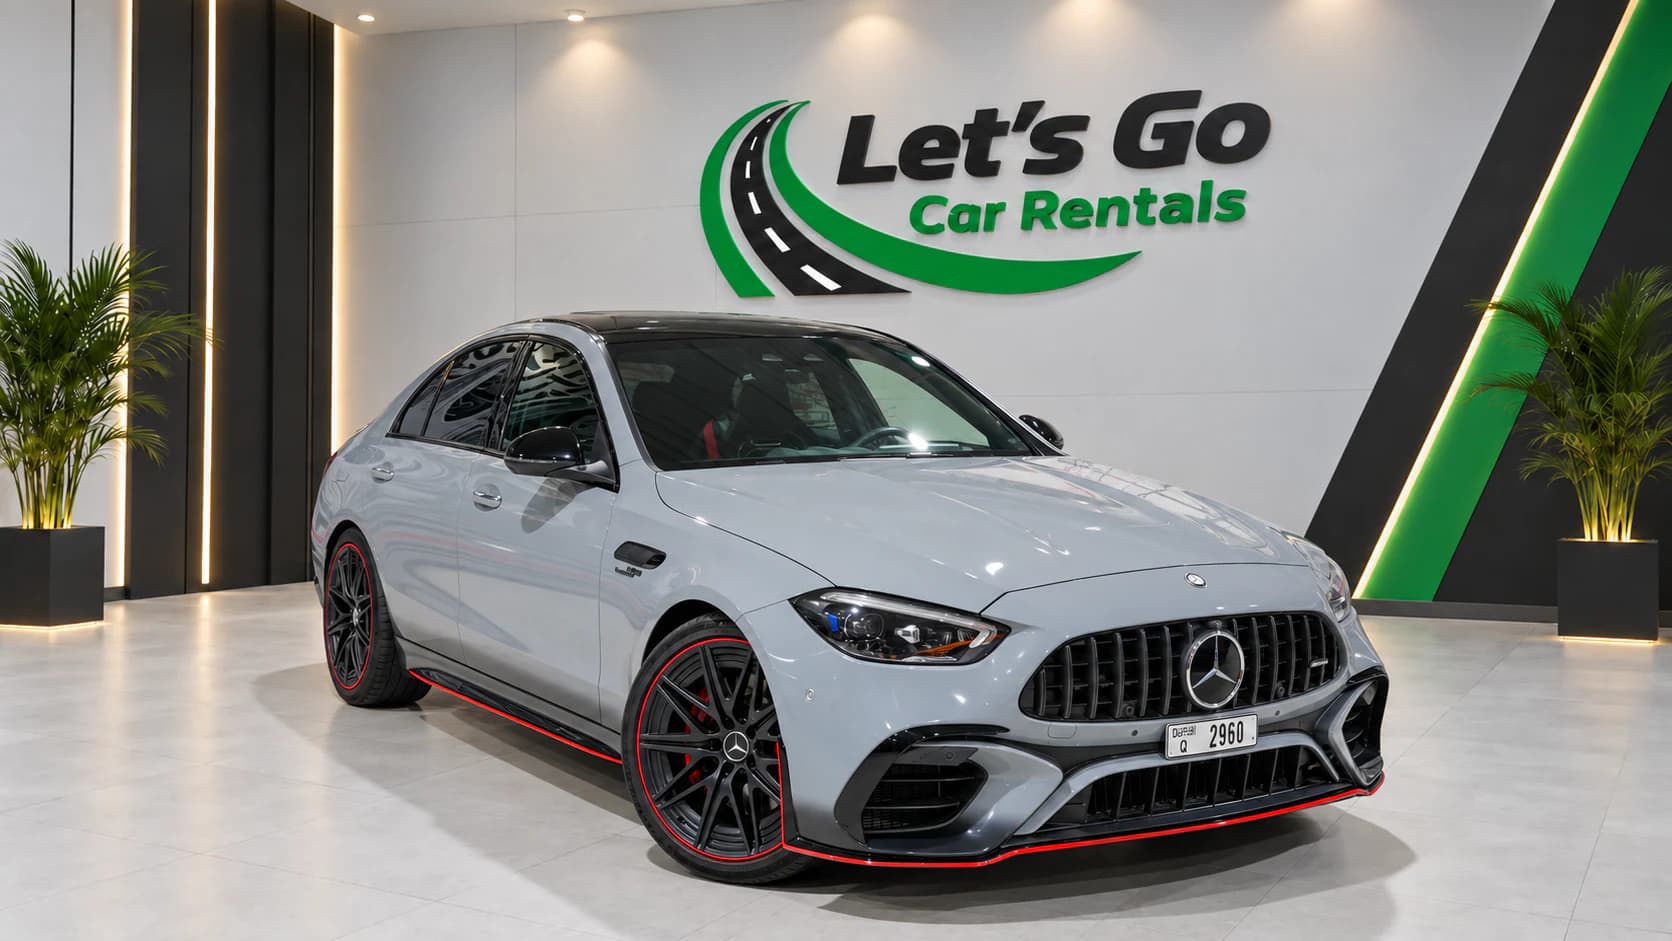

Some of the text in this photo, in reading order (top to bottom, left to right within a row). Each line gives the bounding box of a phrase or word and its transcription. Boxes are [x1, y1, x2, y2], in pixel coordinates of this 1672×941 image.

[836, 89, 1271, 185] Let's Go
[909, 179, 1247, 235] Car Rentals
[1180, 739, 1188, 753] Q
[1209, 721, 1244, 748] 2960
